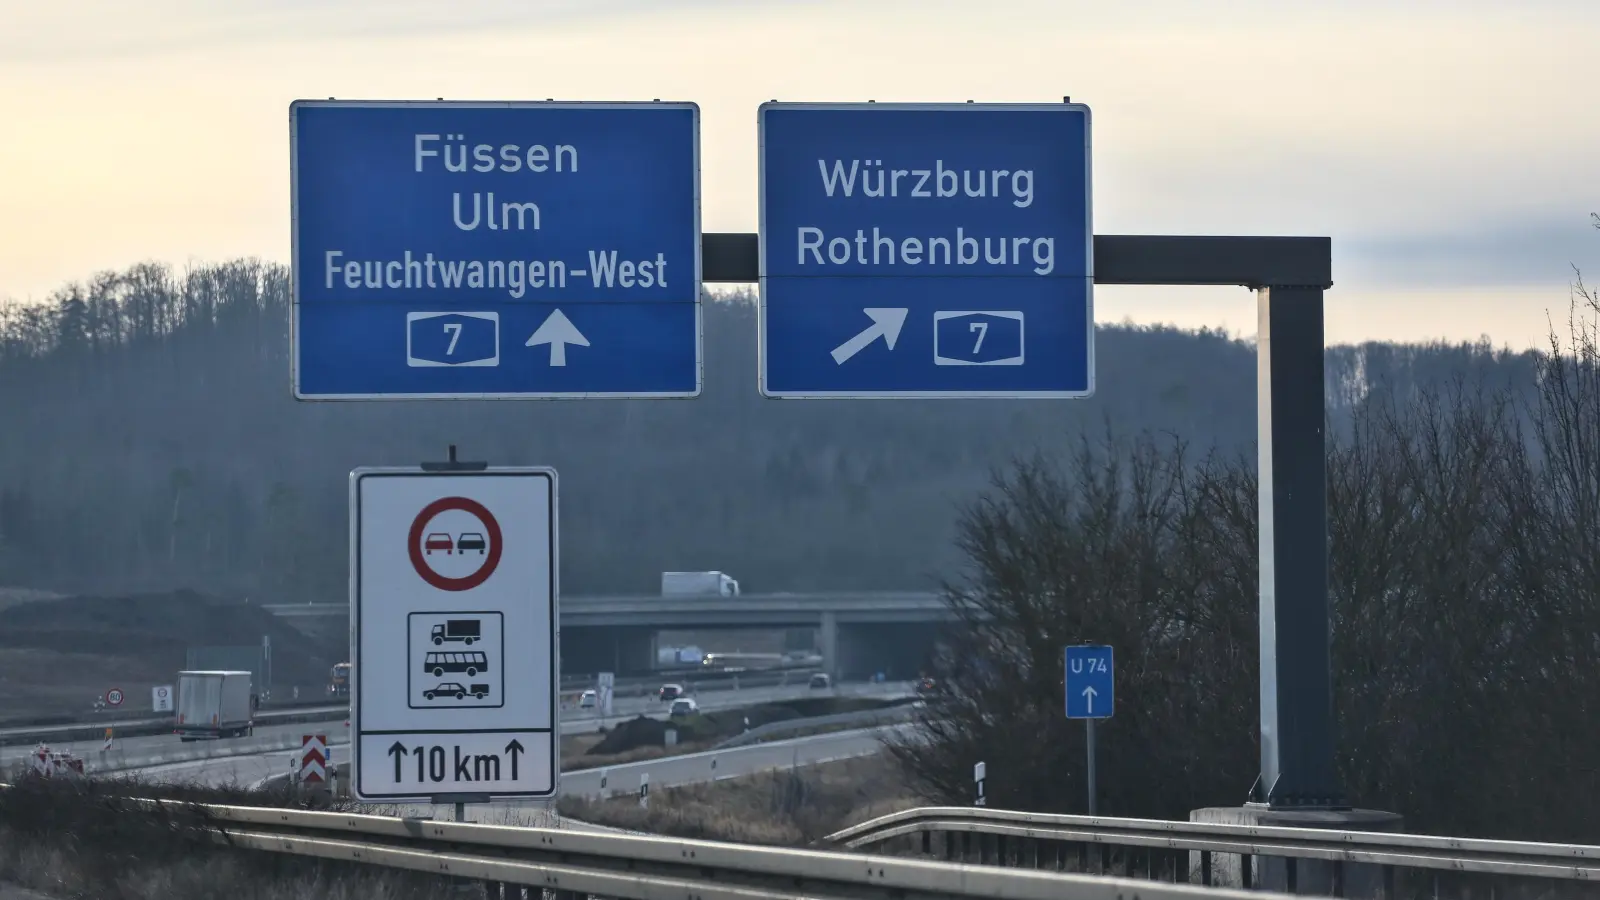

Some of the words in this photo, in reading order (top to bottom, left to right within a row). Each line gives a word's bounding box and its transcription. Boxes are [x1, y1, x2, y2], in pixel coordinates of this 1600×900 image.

[414, 133, 578, 173] Füssen
[818, 159, 1035, 208] Würzburg
[452, 192, 540, 231] Ulm
[797, 227, 1055, 276] Rothenburg
[325, 250, 668, 299] Feuchtwangen-West
[443, 323, 462, 356] 7
[969, 322, 988, 354] 7
[1071, 658, 1082, 673] U
[1087, 658, 1107, 673] 74
[413, 745, 445, 782] 10
[454, 745, 500, 781] km
